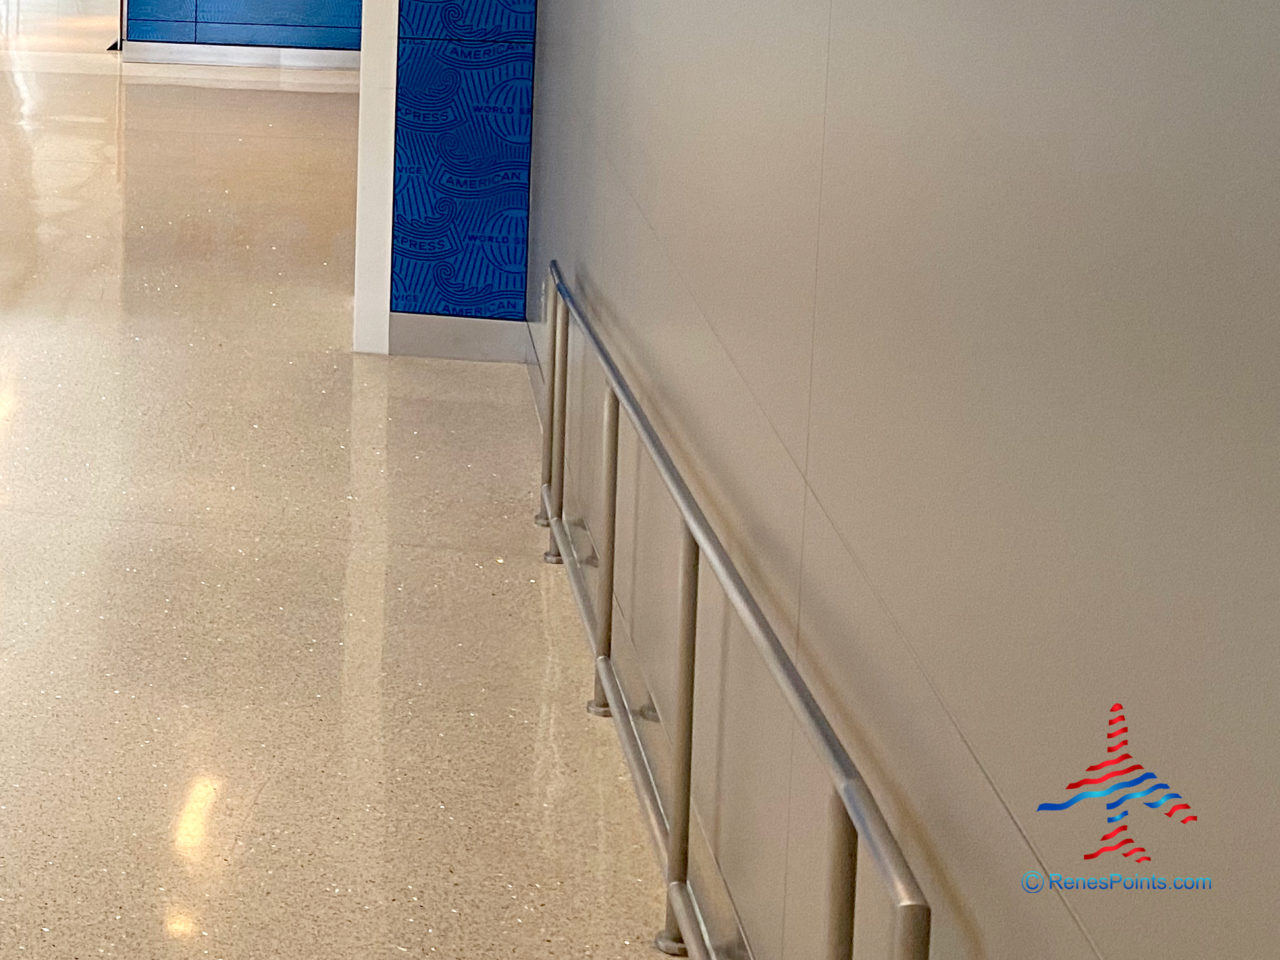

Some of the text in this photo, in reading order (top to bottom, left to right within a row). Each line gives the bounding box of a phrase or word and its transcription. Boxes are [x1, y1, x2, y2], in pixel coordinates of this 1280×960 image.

[449, 43, 527, 60] AMERICAN
[472, 105, 515, 115] WORLD
[444, 171, 521, 189] AMERICAN
[467, 235, 510, 245] WORLD
